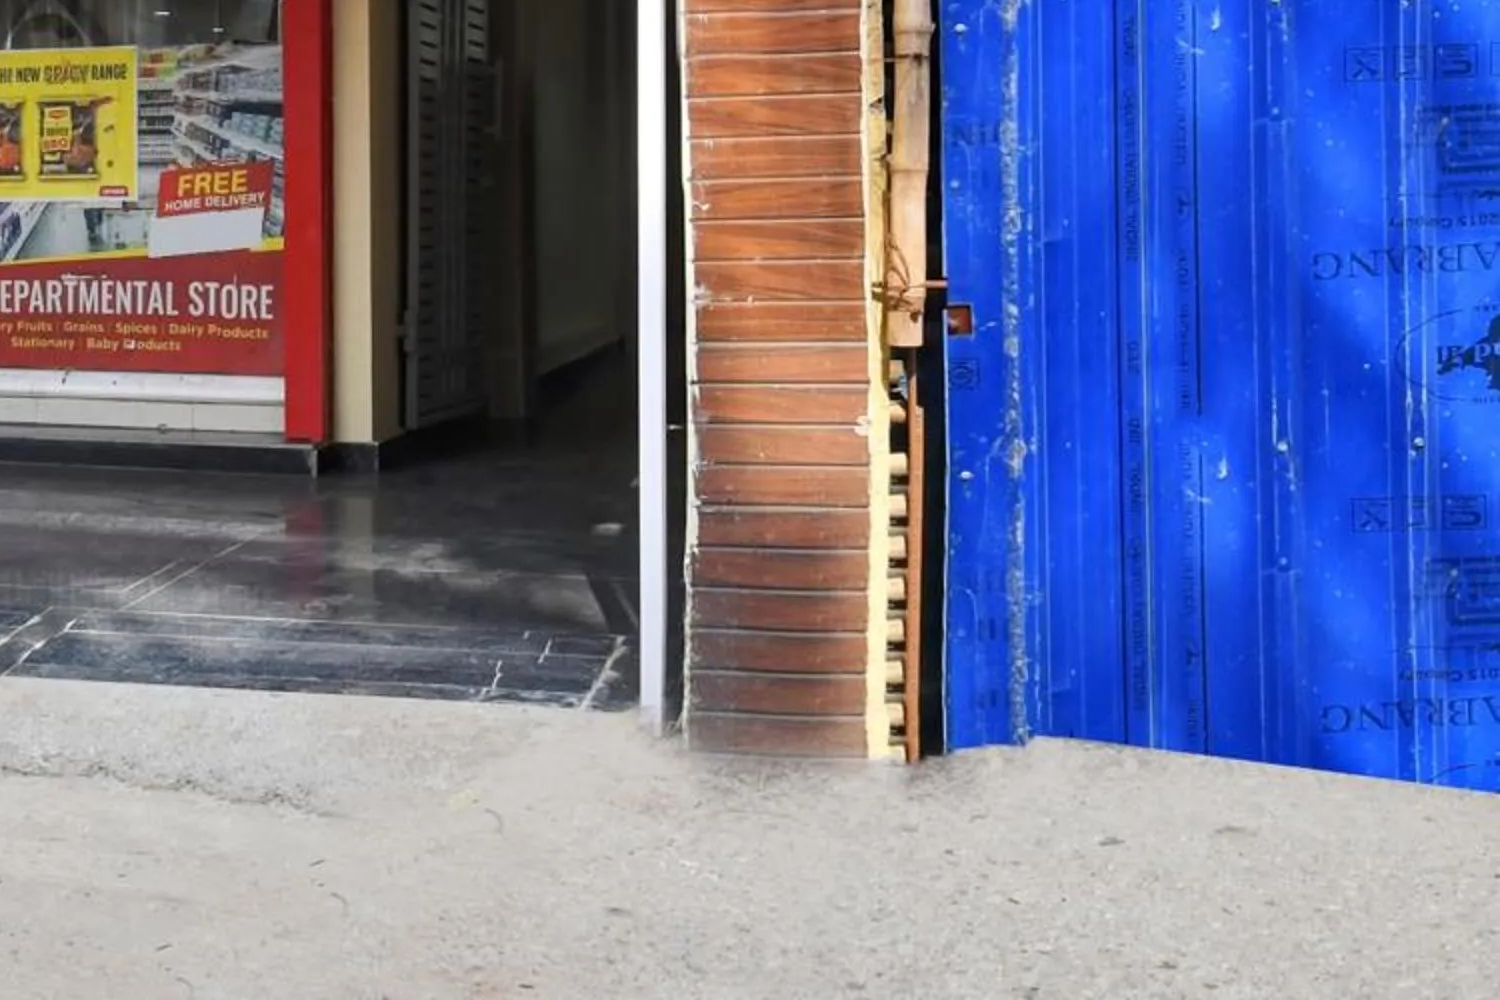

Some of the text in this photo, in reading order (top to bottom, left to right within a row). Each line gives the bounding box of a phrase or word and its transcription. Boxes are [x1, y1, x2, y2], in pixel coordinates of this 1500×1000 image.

[15, 66, 41, 82] NEW
[91, 63, 128, 80] RANGE
[177, 168, 248, 197] FREE
[164, 191, 265, 212] HOME DELIVERY
[188, 281, 275, 320] STORE
[17, 320, 53, 333] Fruits
[63, 321, 104, 334] Grains
[115, 322, 157, 336] Spices
[169, 322, 205, 337] Dairy
[208, 323, 270, 339] Products
[87, 337, 119, 352] Baby
